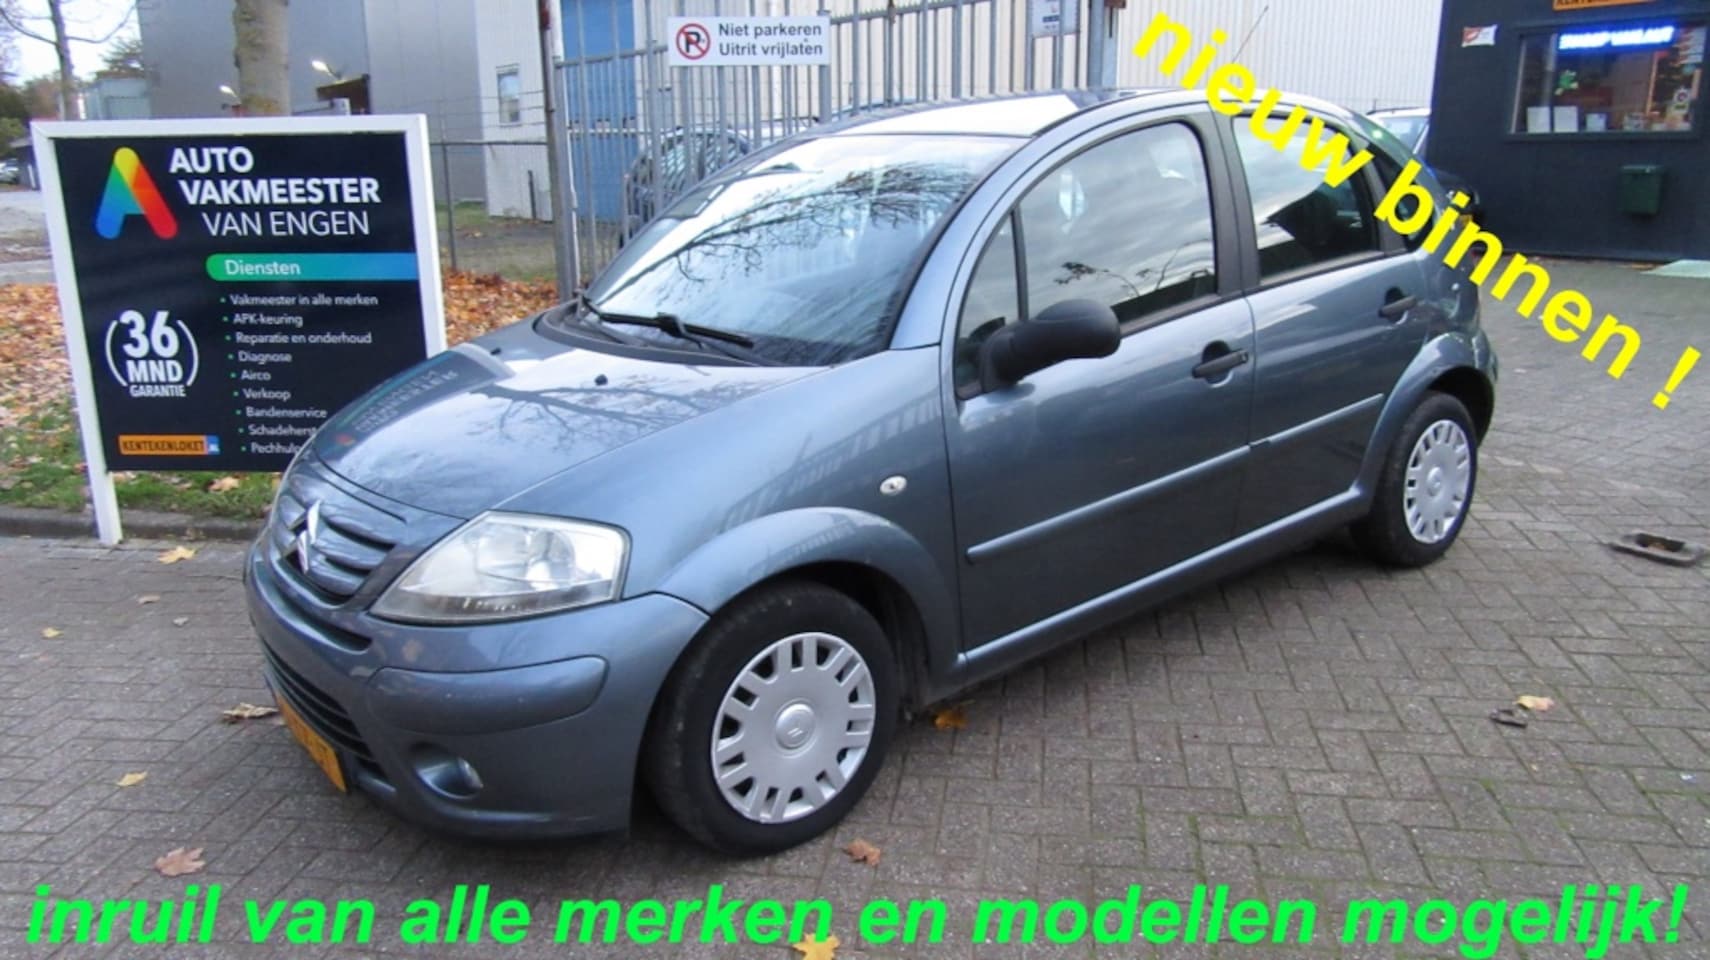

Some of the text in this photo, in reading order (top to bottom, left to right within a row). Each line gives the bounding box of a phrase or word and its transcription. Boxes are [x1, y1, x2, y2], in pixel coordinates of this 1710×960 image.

[718, 23, 822, 39] Niet parkeren
[719, 42, 823, 59] Uitrit vrijlaten
[169, 146, 254, 173] AUTO
[178, 177, 381, 205] VAKMEESTER
[202, 210, 370, 236] VAN ENGEN
[224, 259, 301, 276] Diensten
[230, 293, 378, 305] Vakmeester in alle merken
[233, 313, 303, 327] APK-keuring
[119, 309, 180, 359] 36
[236, 331, 372, 345] Reparatie en onderhoud
[238, 350, 292, 364] Diagnose
[126, 359, 183, 383] MND
[241, 369, 272, 381] Airco
[129, 384, 186, 397] GARANTIE
[242, 387, 291, 402] Verkoop
[245, 406, 328, 418] Bandenservice
